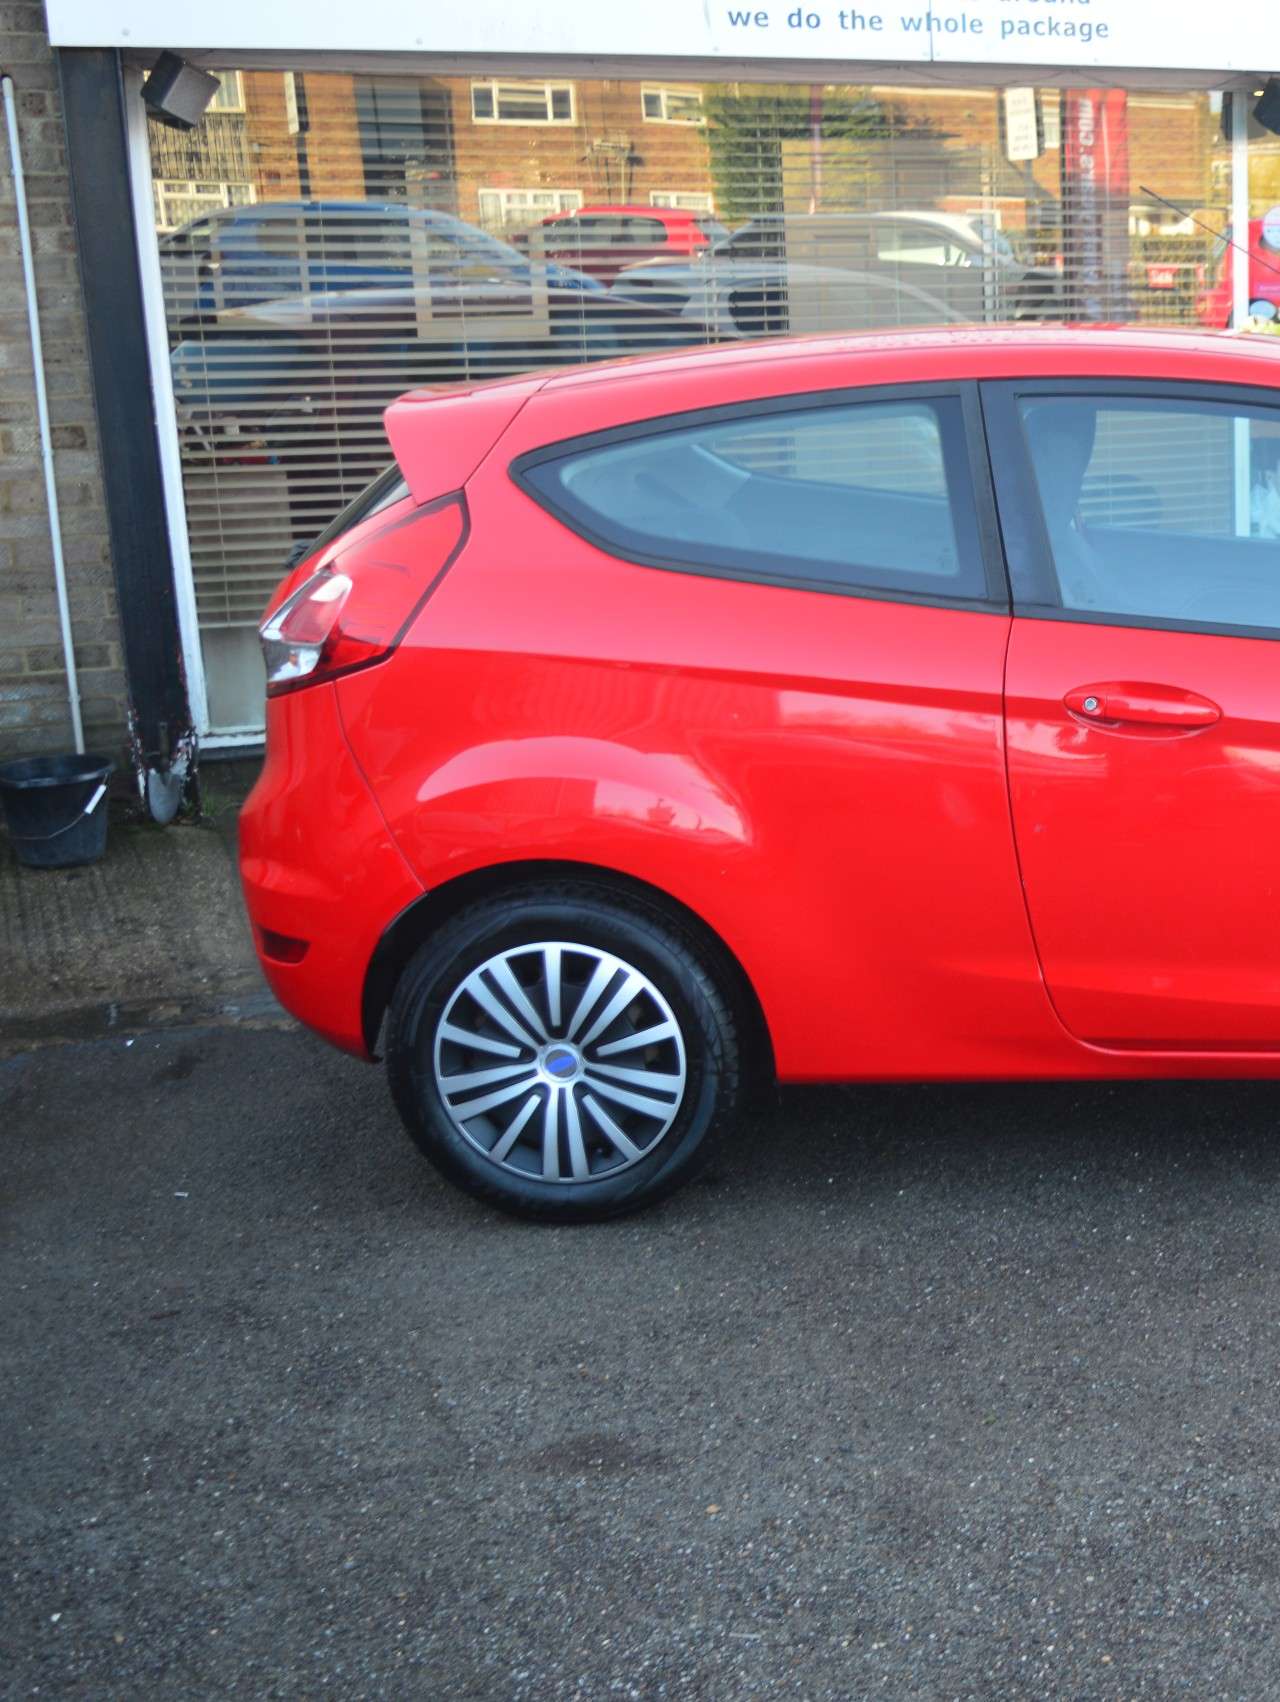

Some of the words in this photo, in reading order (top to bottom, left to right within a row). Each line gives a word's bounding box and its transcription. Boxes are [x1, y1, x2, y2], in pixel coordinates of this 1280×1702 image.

[728, 10, 769, 28] we
[787, 8, 821, 29] do
[838, 9, 883, 31] the
[900, 12, 983, 34] whole
[1001, 16, 1109, 43] package
